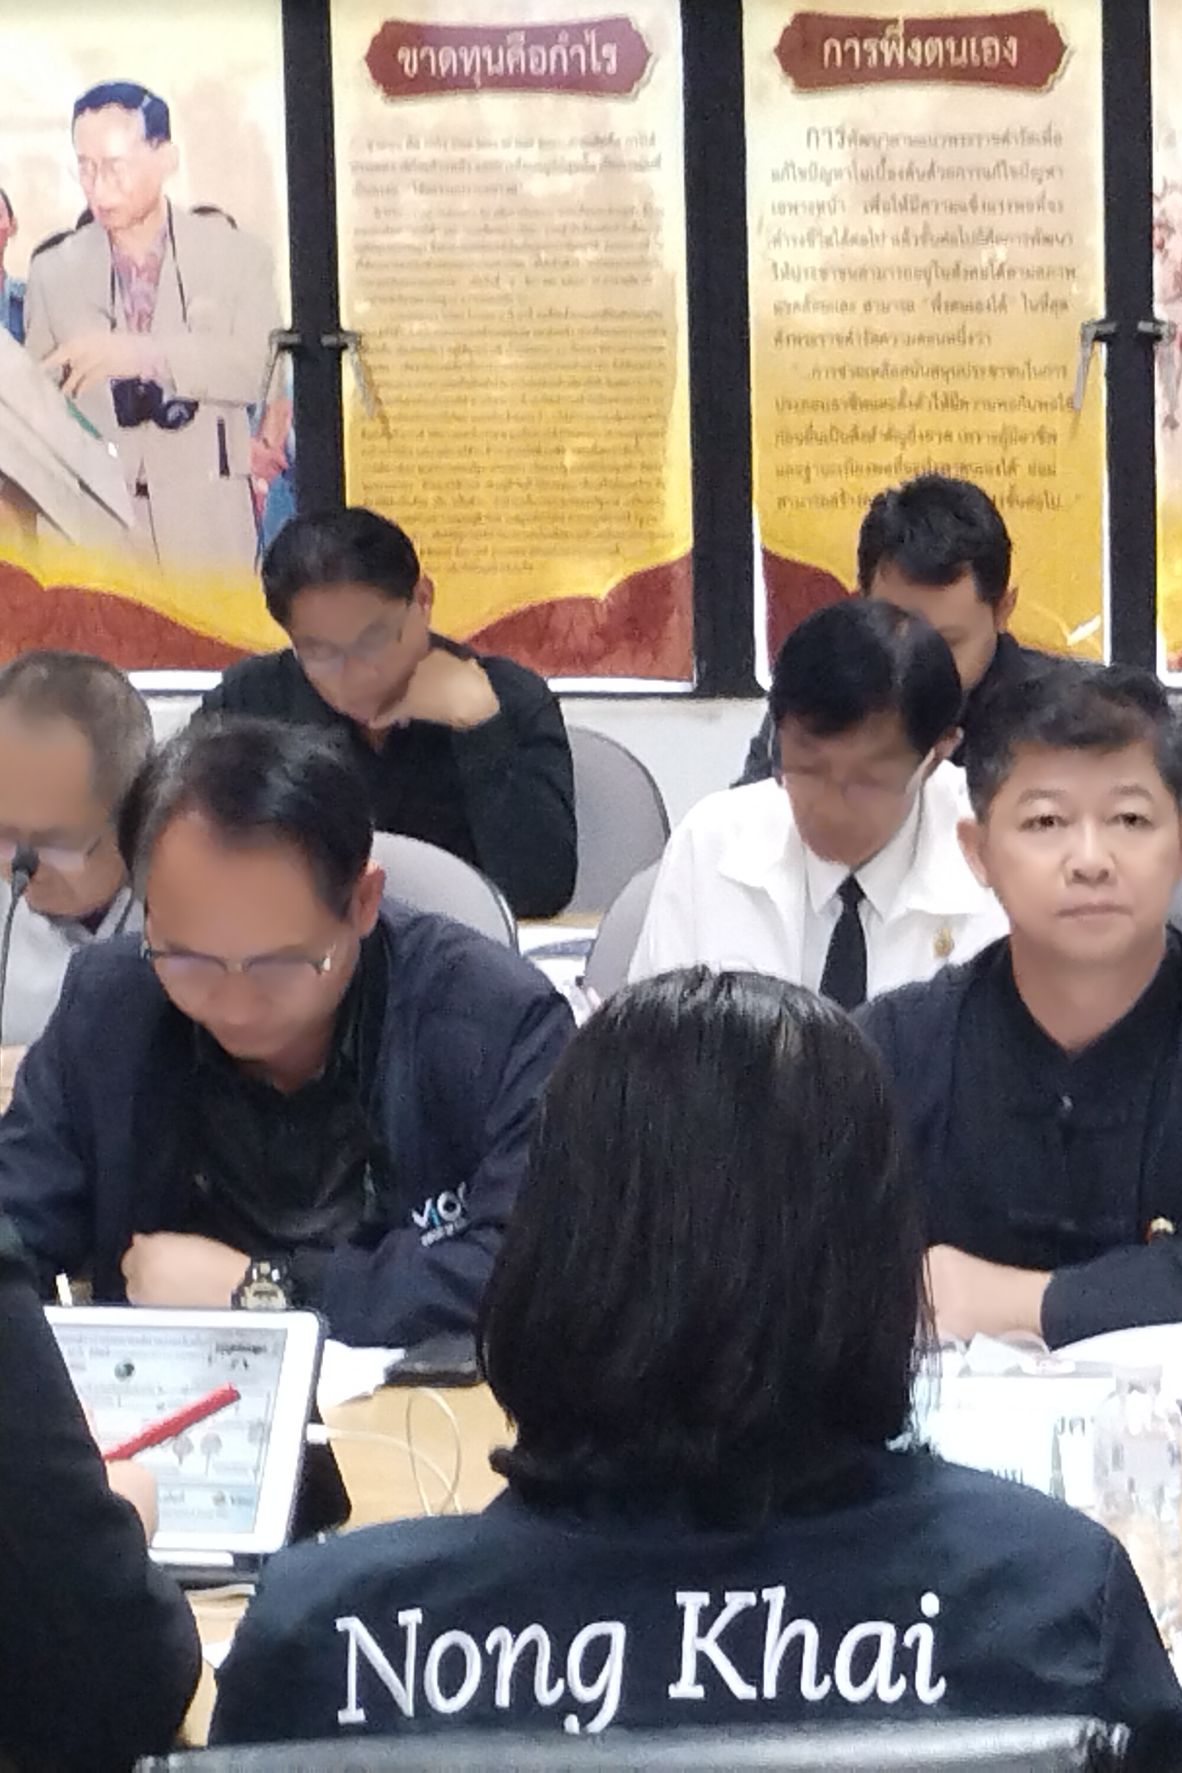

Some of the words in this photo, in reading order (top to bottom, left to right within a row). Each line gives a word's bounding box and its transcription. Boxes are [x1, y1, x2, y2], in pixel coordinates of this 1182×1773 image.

[396, 28, 618, 89] ขาดทุนคือกำไร
[822, 17, 1019, 69] การพึ่งตนเอง
[336, 1608, 627, 1733] Nong
[668, 1585, 947, 1705] Khai
